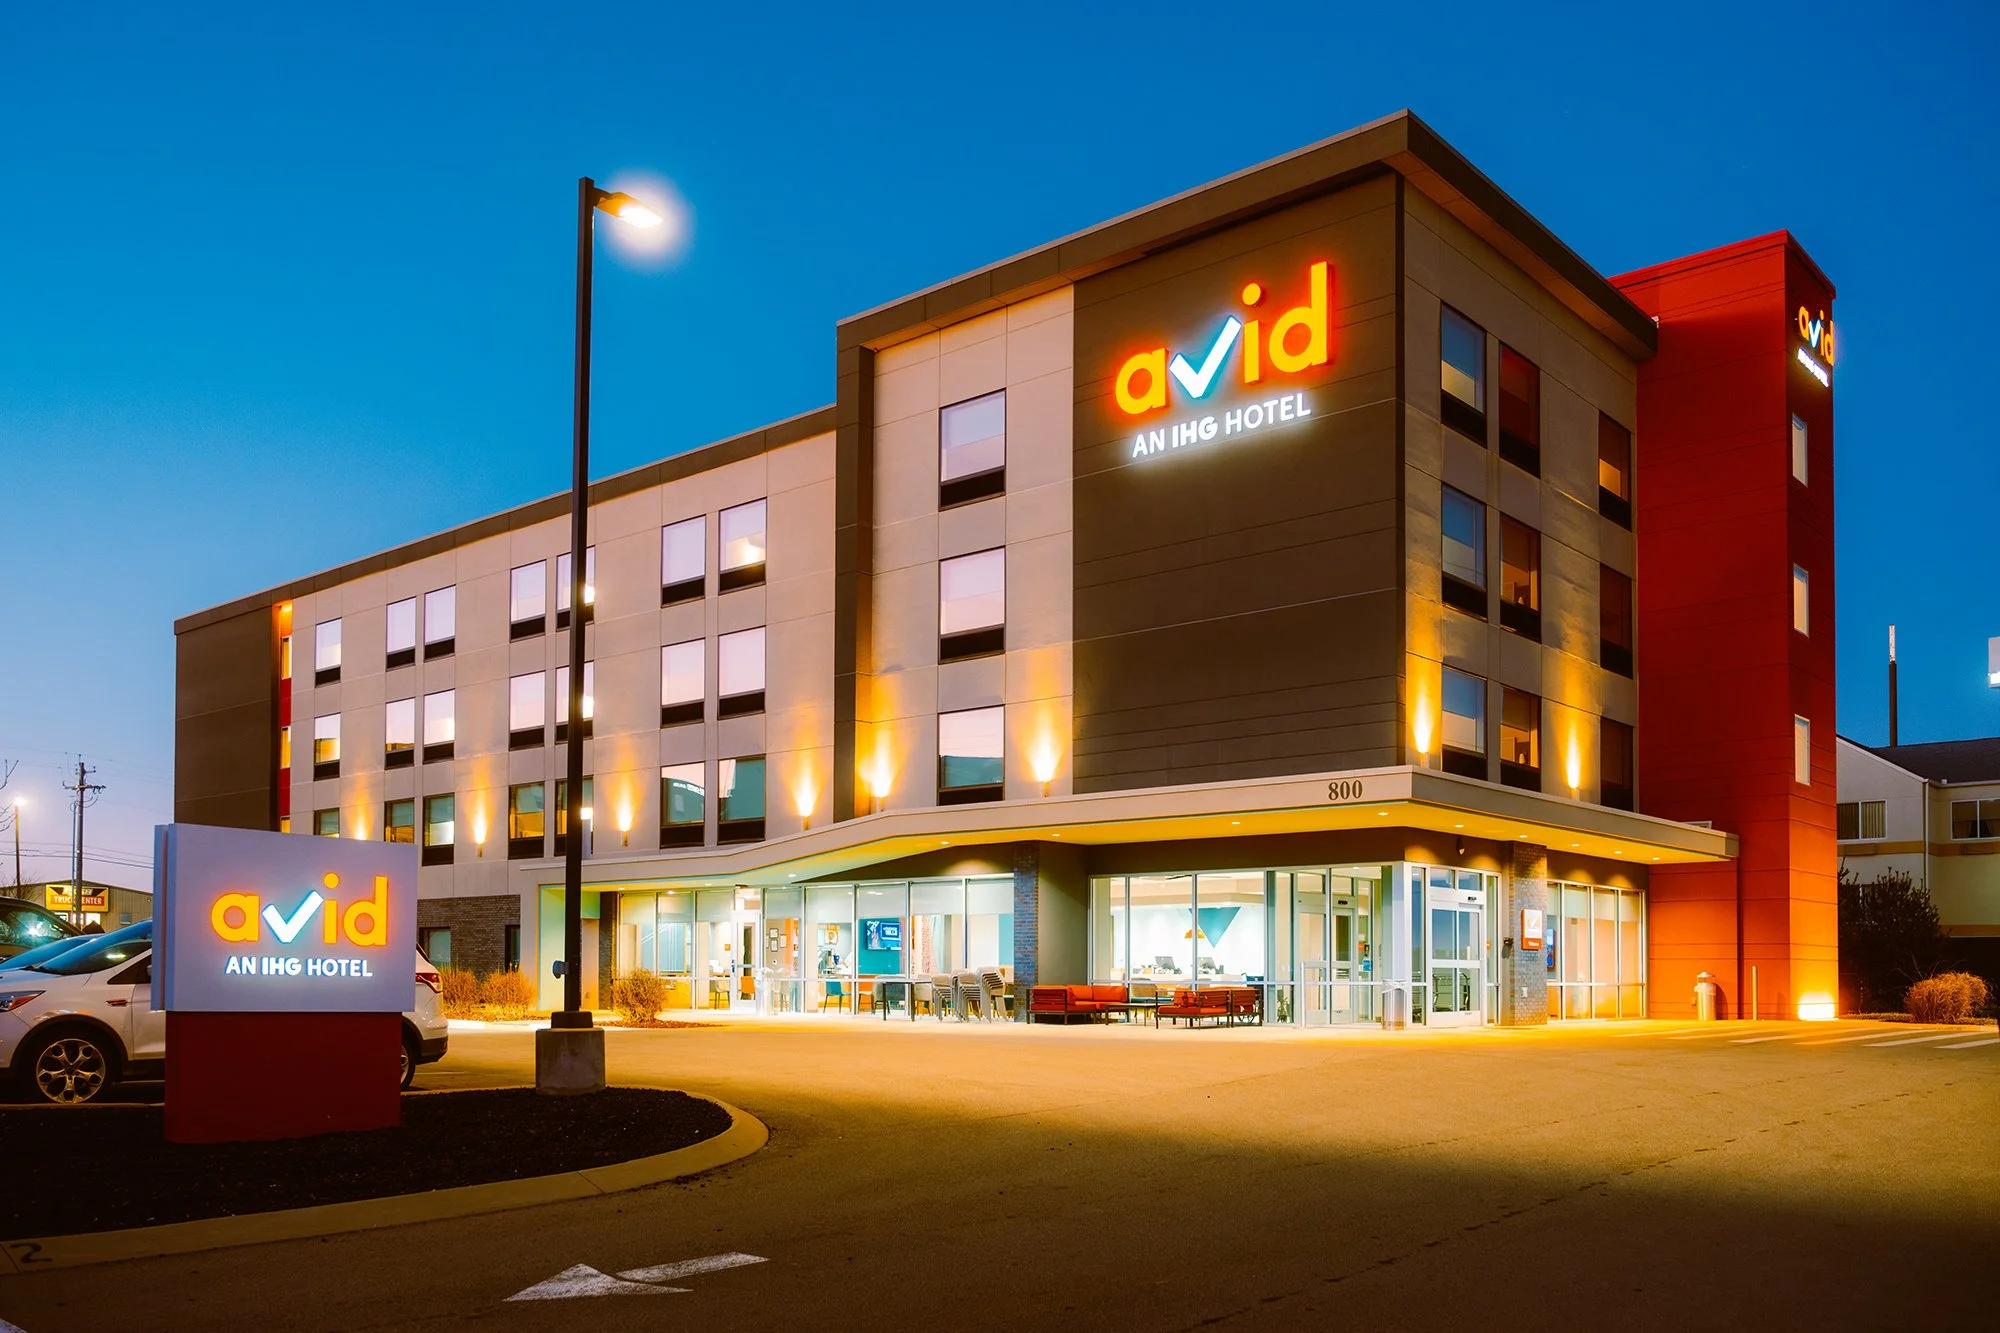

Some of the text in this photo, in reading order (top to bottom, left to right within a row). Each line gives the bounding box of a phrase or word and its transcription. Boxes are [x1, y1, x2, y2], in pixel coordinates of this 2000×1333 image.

[1115, 261, 1330, 415] avid
[1132, 392, 1312, 458] AN IHG HOTEL
[1328, 780, 1363, 801] 800
[78, 896, 103, 906] ENTER
[210, 872, 388, 947] avid
[225, 955, 374, 978] AN IHG HOTEL
